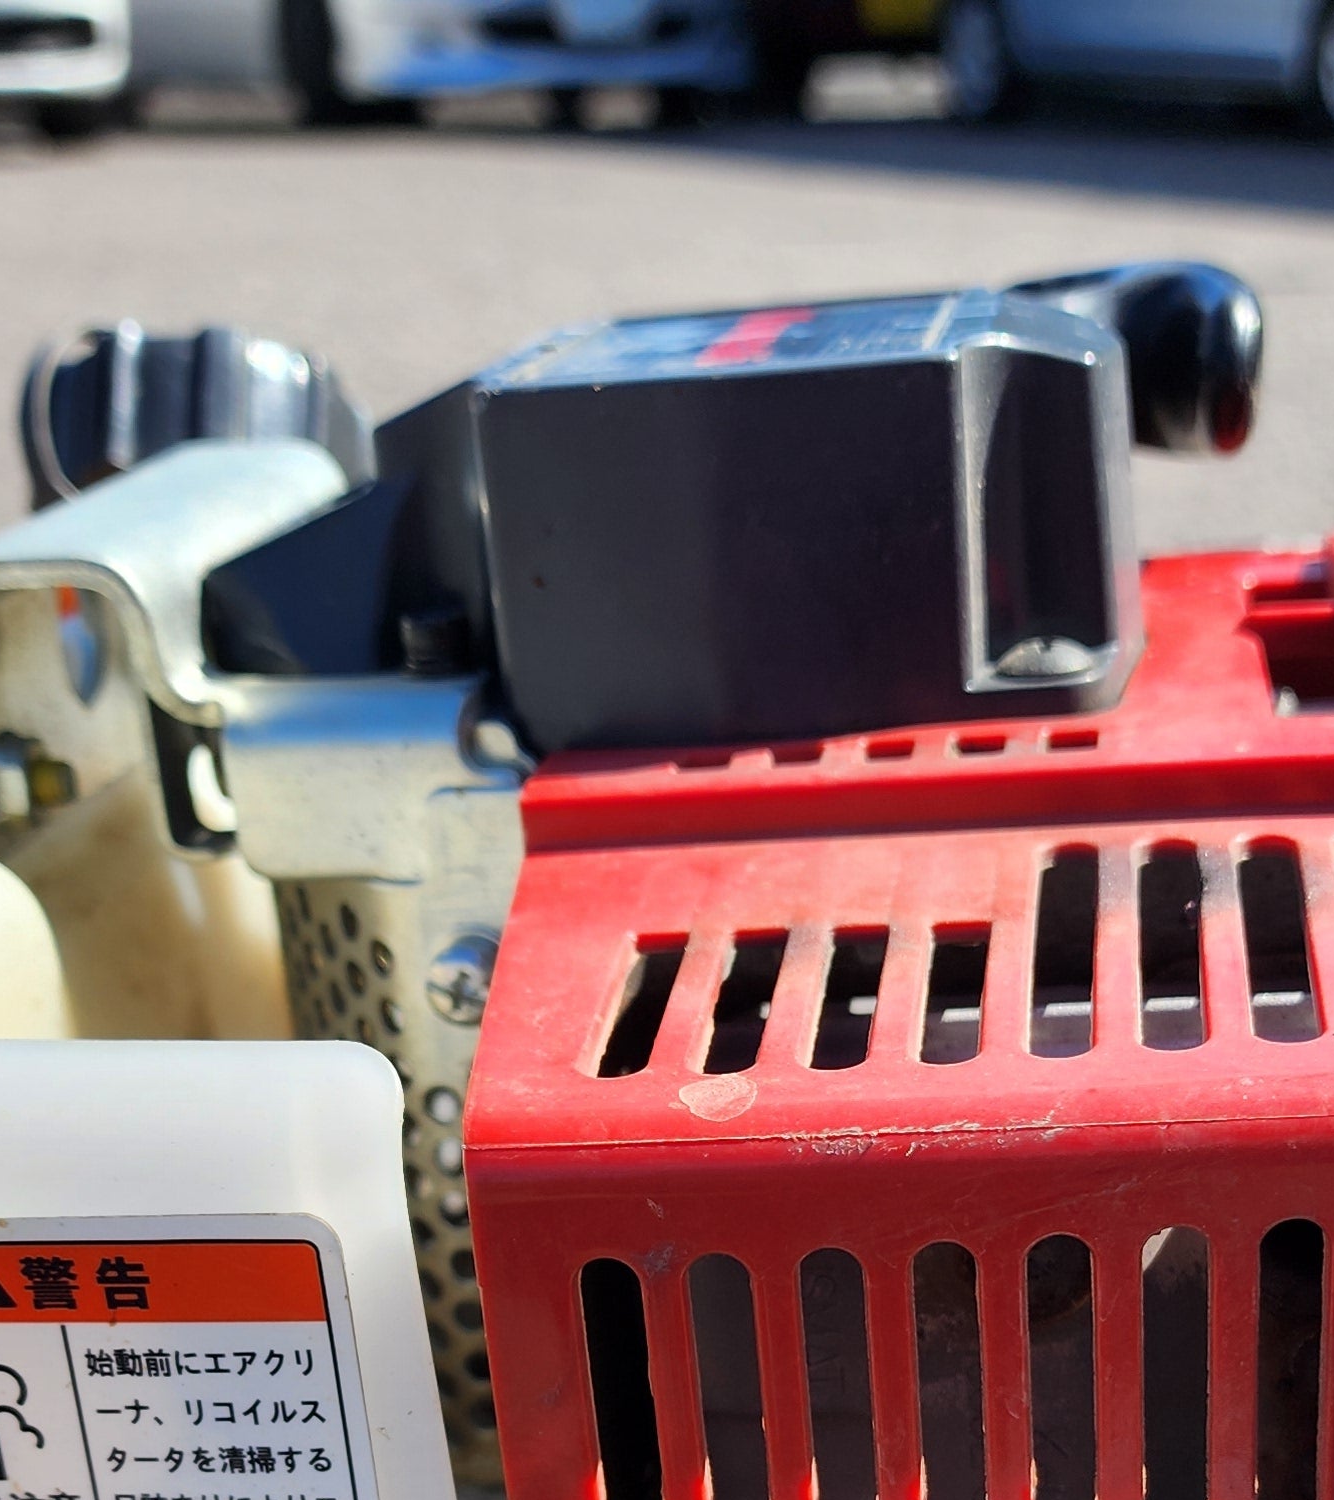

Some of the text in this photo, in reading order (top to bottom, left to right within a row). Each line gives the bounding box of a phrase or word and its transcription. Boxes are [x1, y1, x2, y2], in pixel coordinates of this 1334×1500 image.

[19, 1256, 151, 1310] 警告
[85, 1348, 314, 1377] 始動前にエアクリ
[107, 1446, 332, 1474] タータを清掃する
